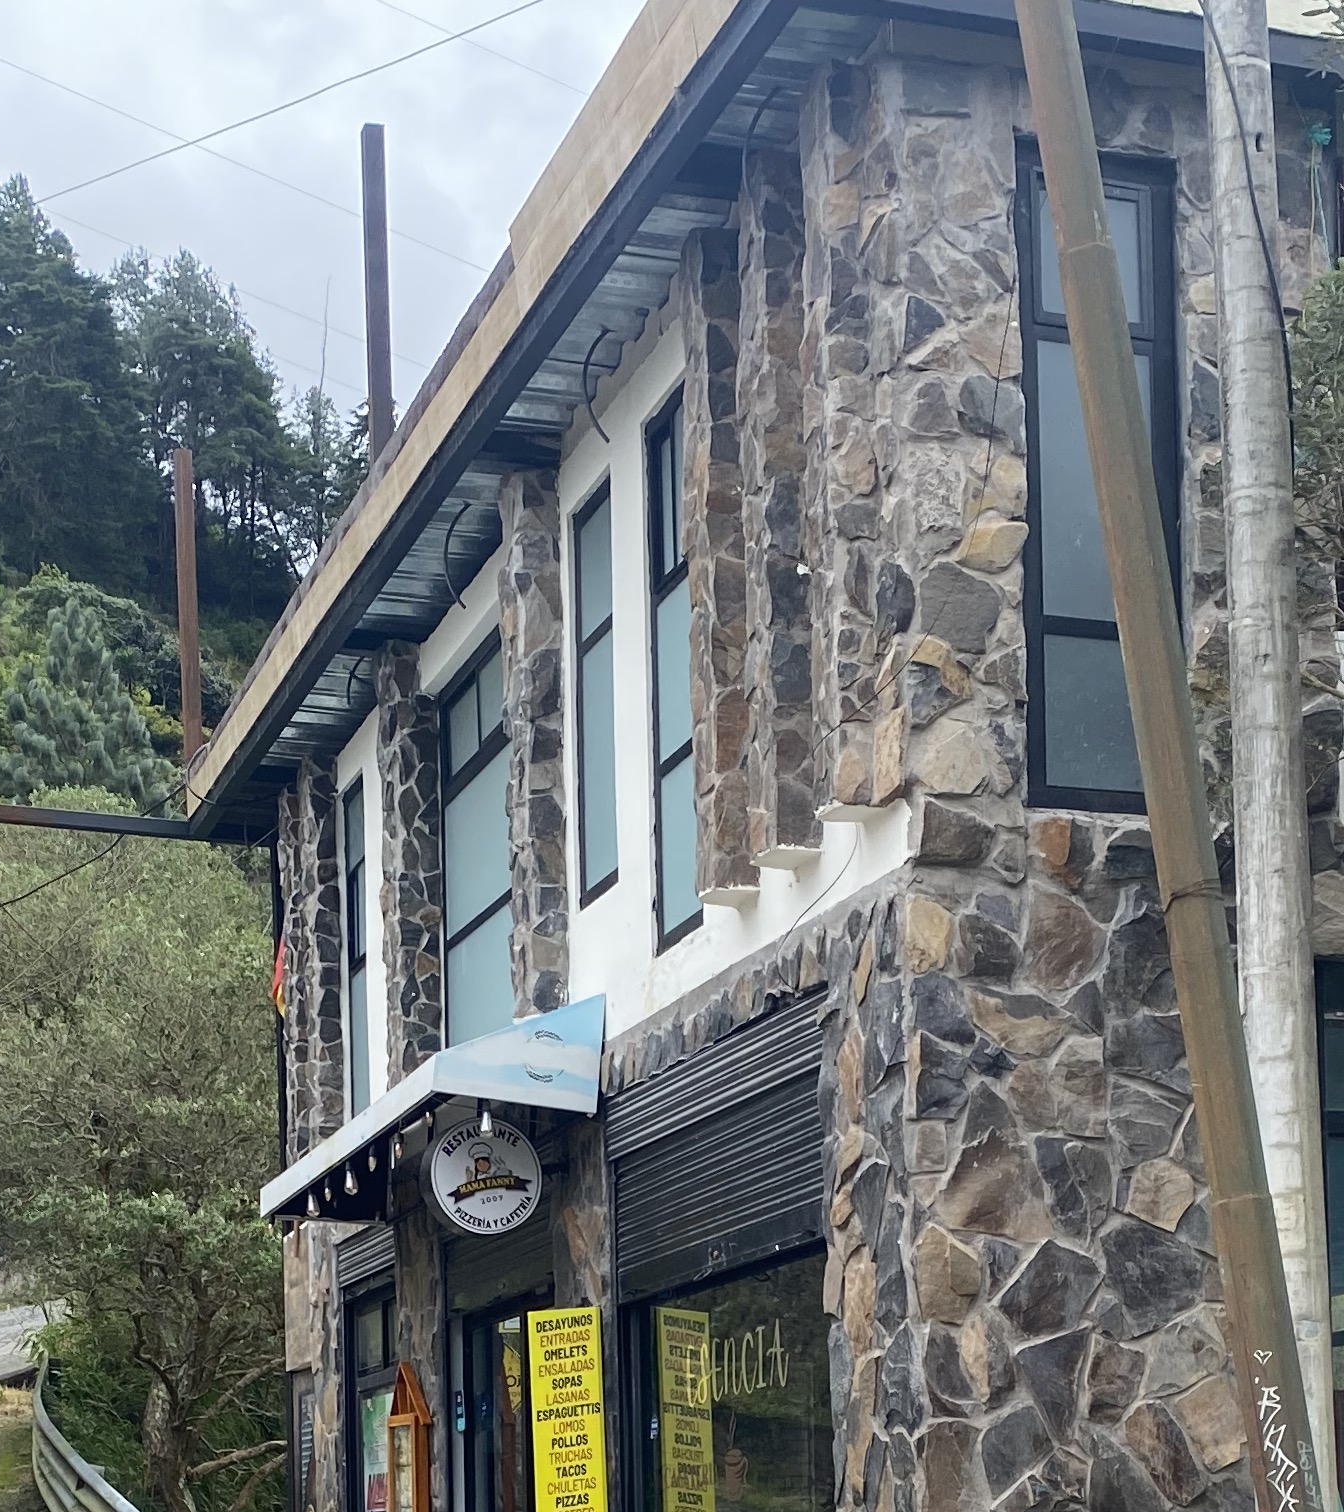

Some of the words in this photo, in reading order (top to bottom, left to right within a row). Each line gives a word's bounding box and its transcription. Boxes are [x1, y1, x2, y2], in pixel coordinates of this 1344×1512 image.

[441, 1124, 521, 1158] RESTAUNTE
[486, 1176, 516, 1188] FANNY
[454, 1206, 492, 1229] PIZZERÍA
[494, 1218, 499, 1228] Y
[536, 1314, 593, 1334] DESAYUNOS
[540, 1329, 591, 1348] ENTRADAS
[544, 1344, 588, 1362] OMELETS
[538, 1358, 595, 1378] ENSALADAS
[552, 1375, 583, 1390] SOPAS
[537, 1402, 601, 1422] ESPAGUETTIS
[553, 1419, 586, 1435] LOMOS
[551, 1434, 588, 1450] POLLOS
[549, 1448, 593, 1466] TRUCHAS
[556, 1464, 587, 1478] TACOS
[547, 1477, 597, 1495] CHULETAS
[555, 1493, 589, 1509] PIZZAS
